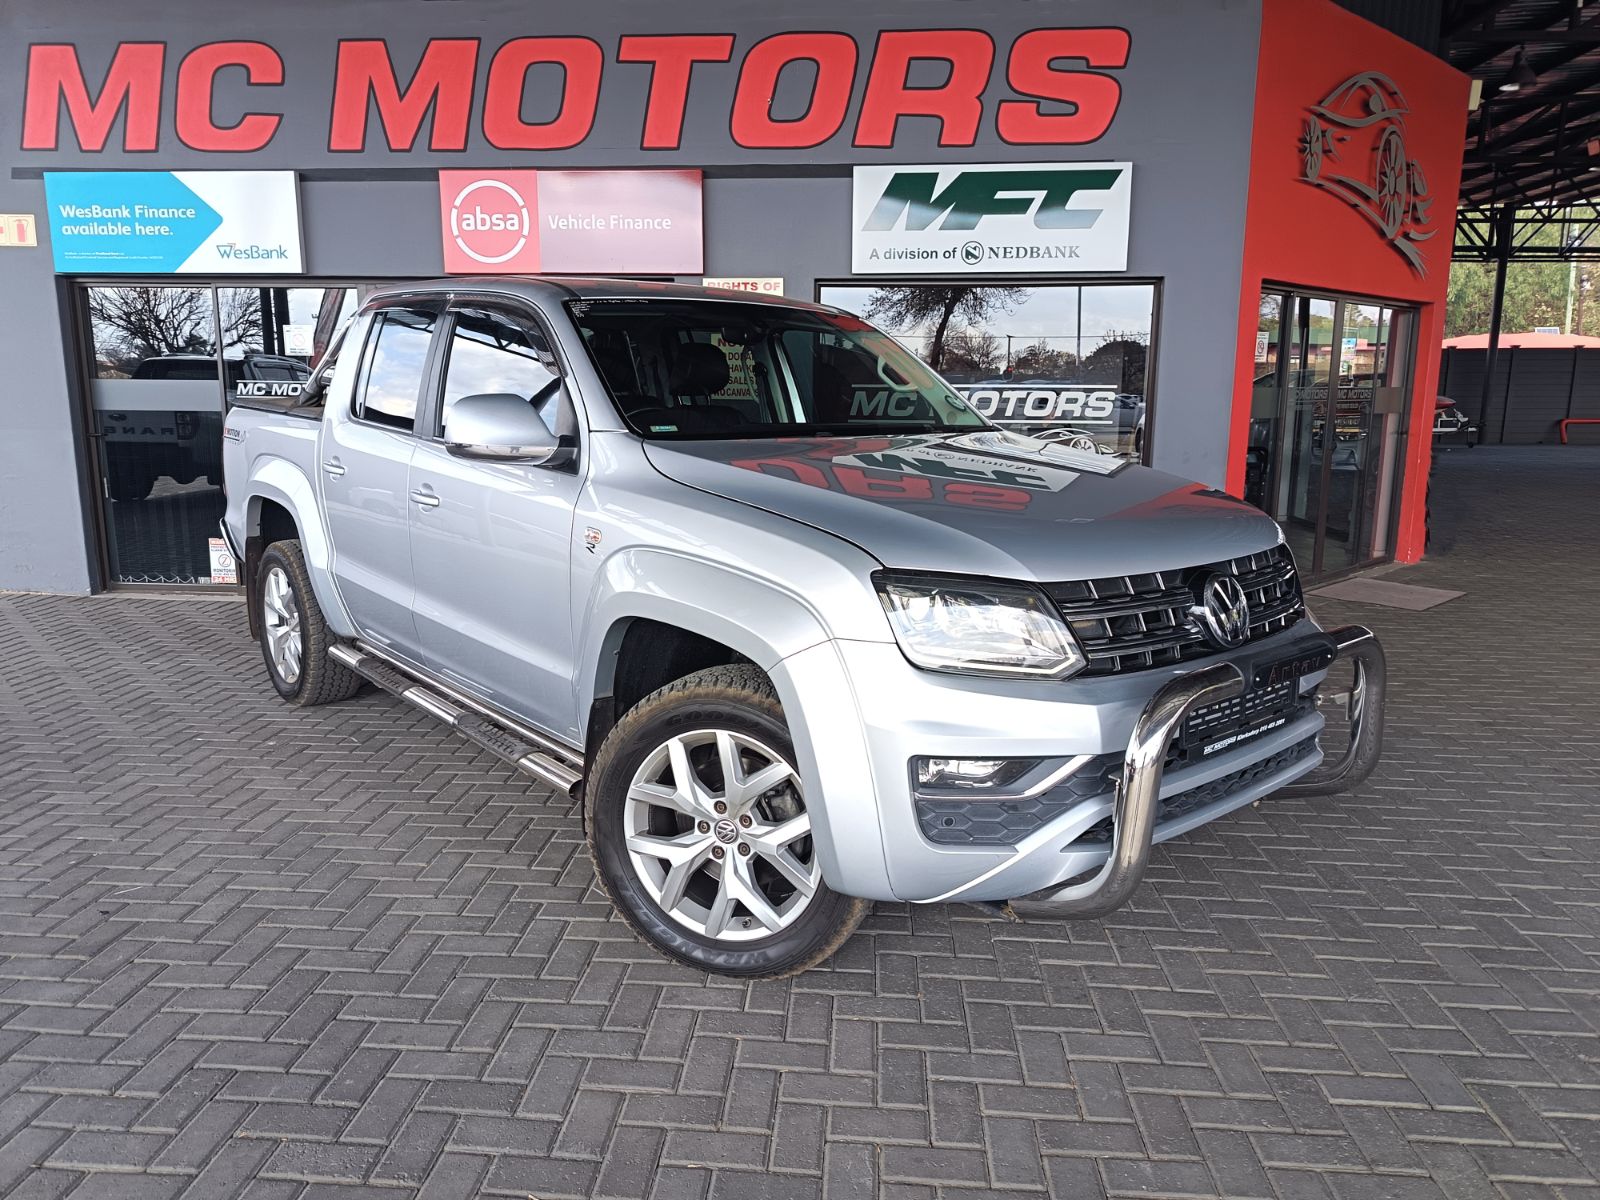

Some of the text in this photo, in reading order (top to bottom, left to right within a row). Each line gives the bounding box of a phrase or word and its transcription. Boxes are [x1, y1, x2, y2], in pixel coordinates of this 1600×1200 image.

[20, 26, 1131, 153] MC MOTORS
[861, 169, 1124, 231] MFC
[59, 204, 196, 219] WesBank Finance
[461, 205, 519, 231] absa
[61, 222, 174, 236] available here.
[548, 215, 672, 230] Vehicle Finance
[216, 243, 288, 260] WesBank
[869, 248, 880, 260] A
[884, 247, 938, 260] division
[943, 247, 957, 259] of
[987, 245, 1081, 260] NEDBANK
[763, 281, 781, 291] OF
[236, 383, 306, 396] MC MO
[849, 390, 1117, 418] MC OTORS
